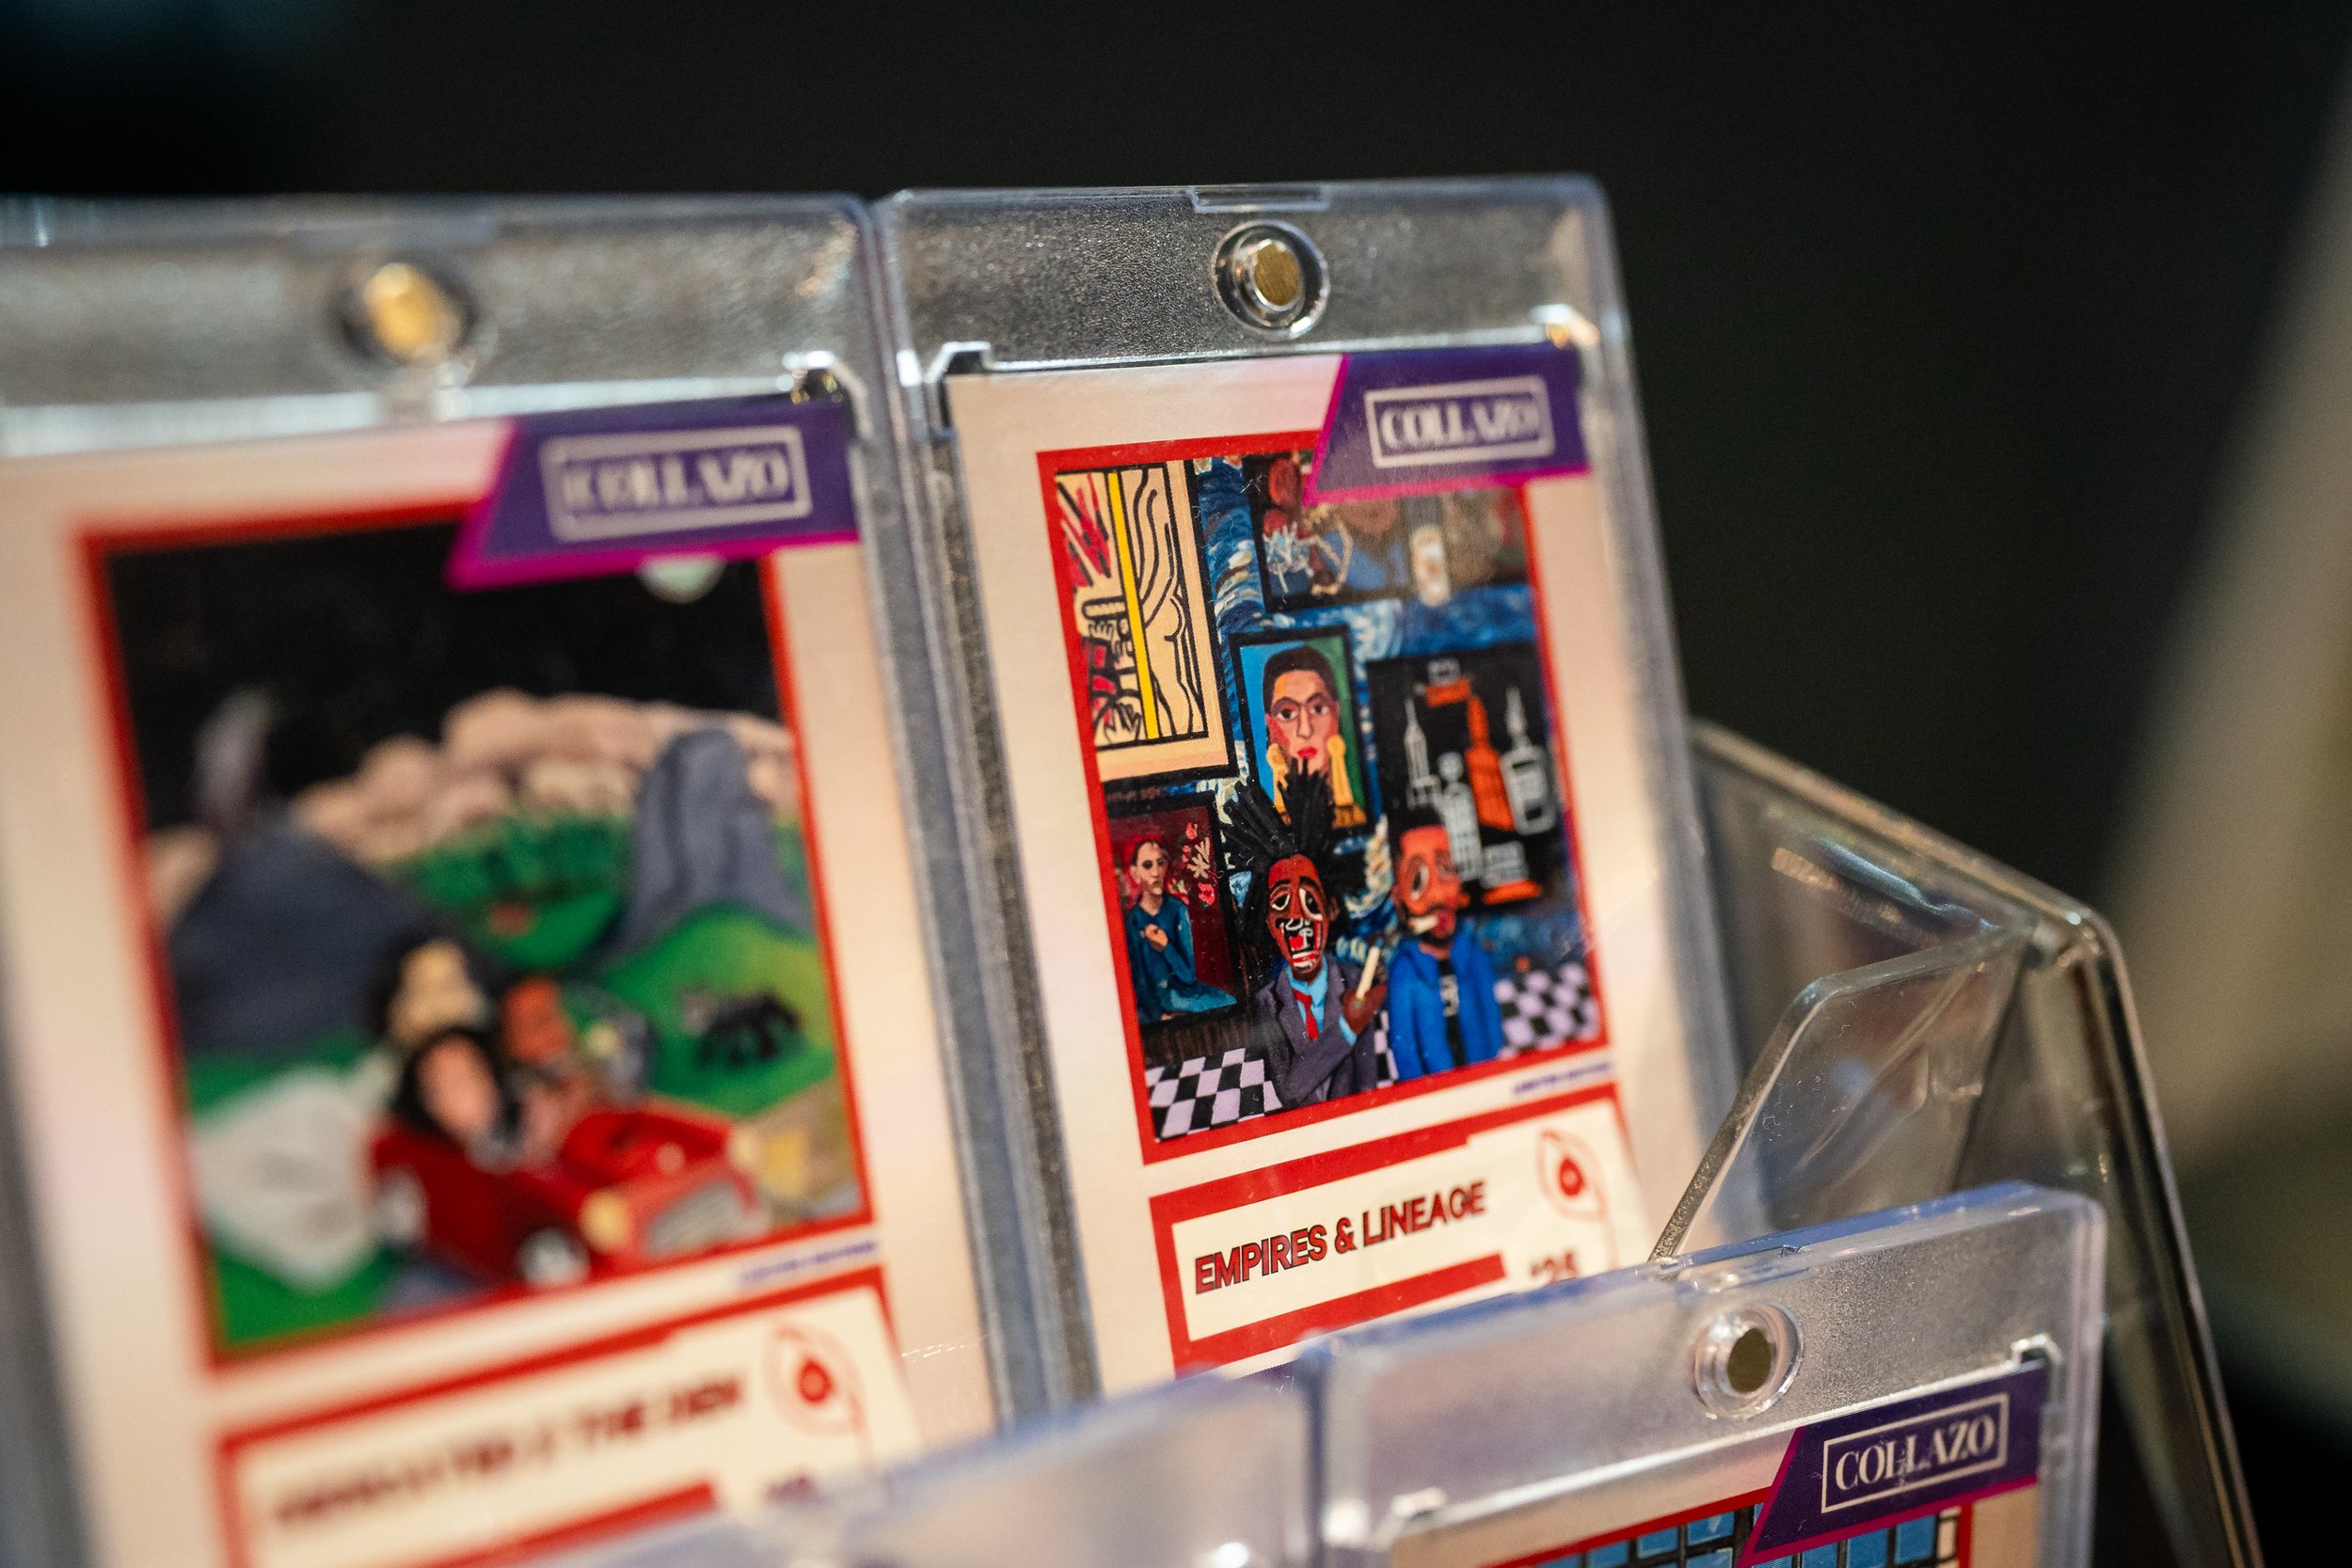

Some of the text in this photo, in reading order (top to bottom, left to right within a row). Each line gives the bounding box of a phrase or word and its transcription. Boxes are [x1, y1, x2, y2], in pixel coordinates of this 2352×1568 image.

[1195, 1181, 1486, 1295] EMPIRES & LINEAGE
[1836, 1413, 1996, 1491] COLLAZO
